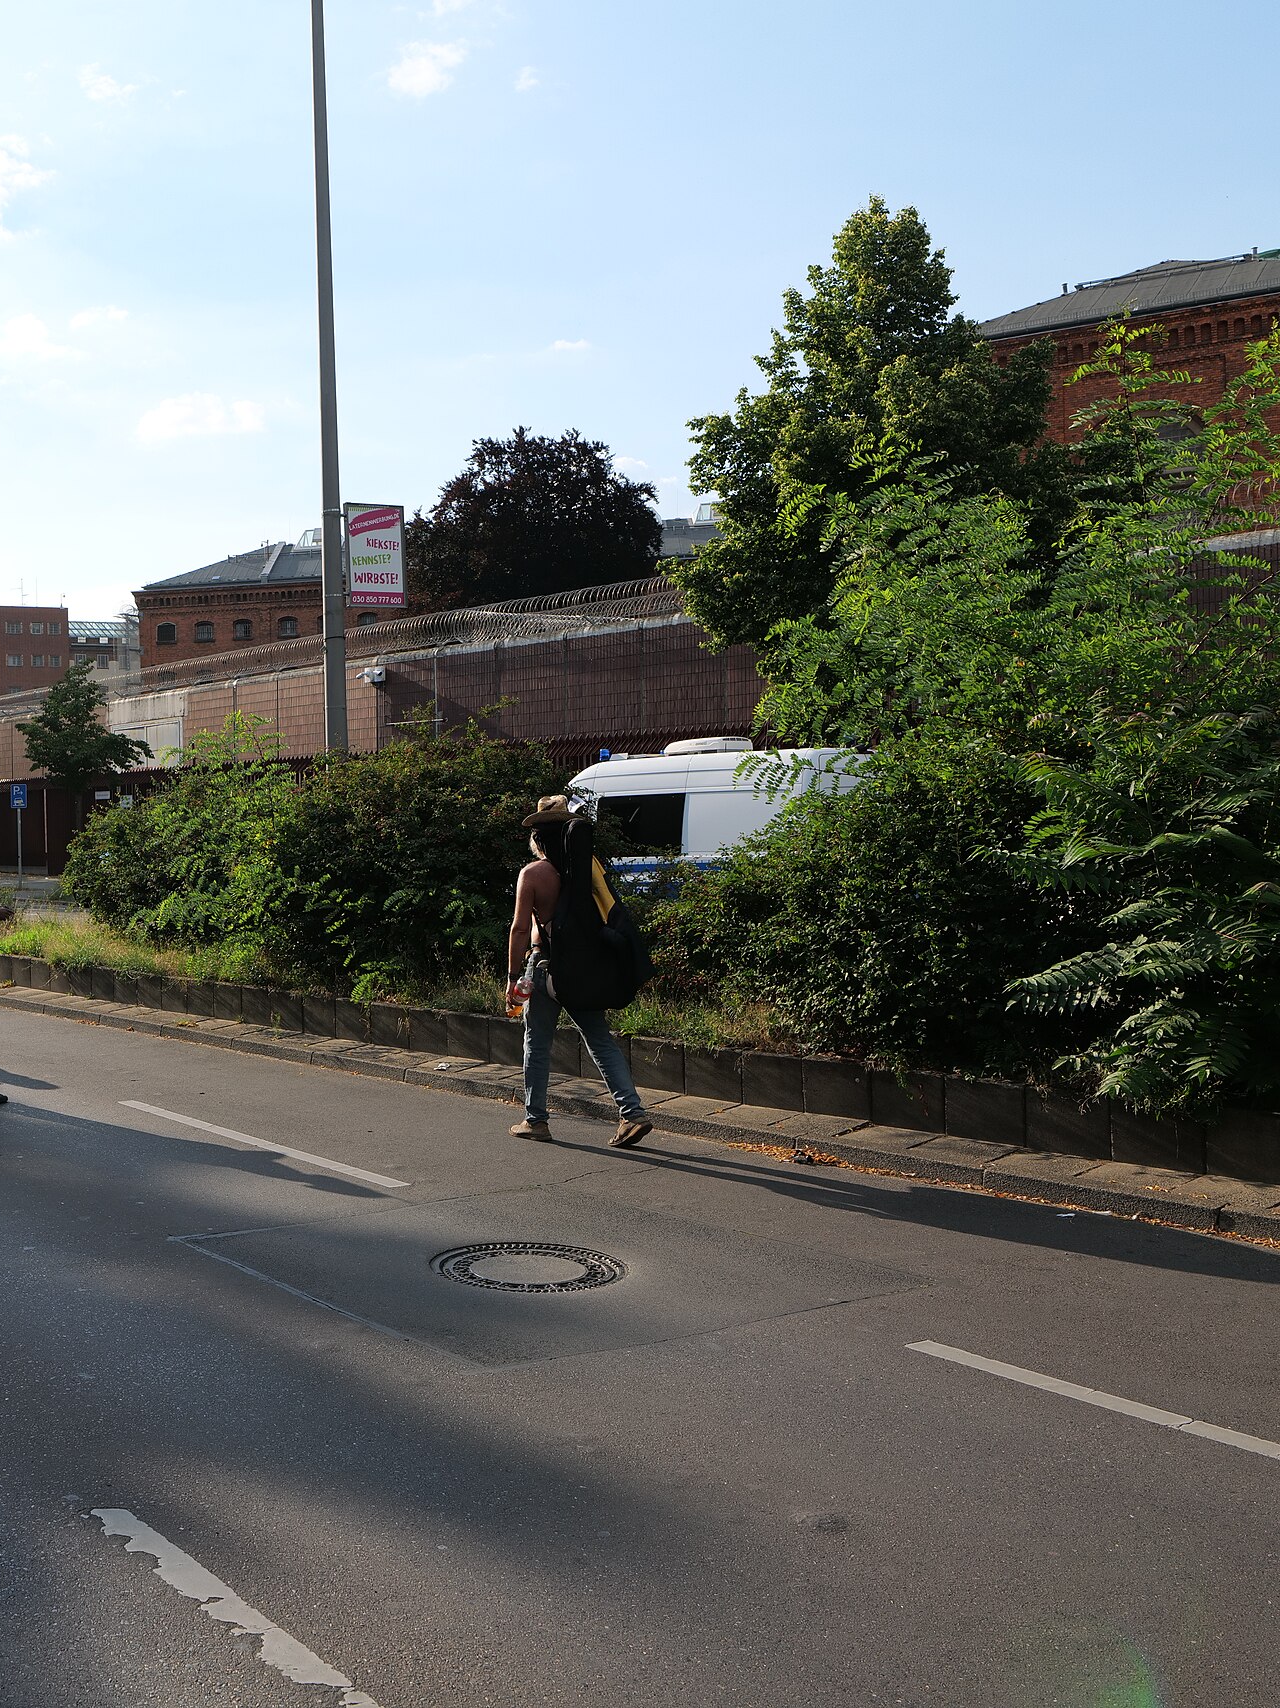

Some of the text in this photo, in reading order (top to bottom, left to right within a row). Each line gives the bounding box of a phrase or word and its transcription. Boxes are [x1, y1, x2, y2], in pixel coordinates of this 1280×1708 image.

[349, 513, 400, 531] LATERNENWERBUNG.DE
[366, 538, 400, 552] KIEKSTE!
[352, 554, 391, 567] KENNSTE?
[354, 572, 399, 585] WIRBSTE!
[352, 595, 365, 603] 030
[366, 595, 378, 604] 850
[378, 596, 389, 604] 777
